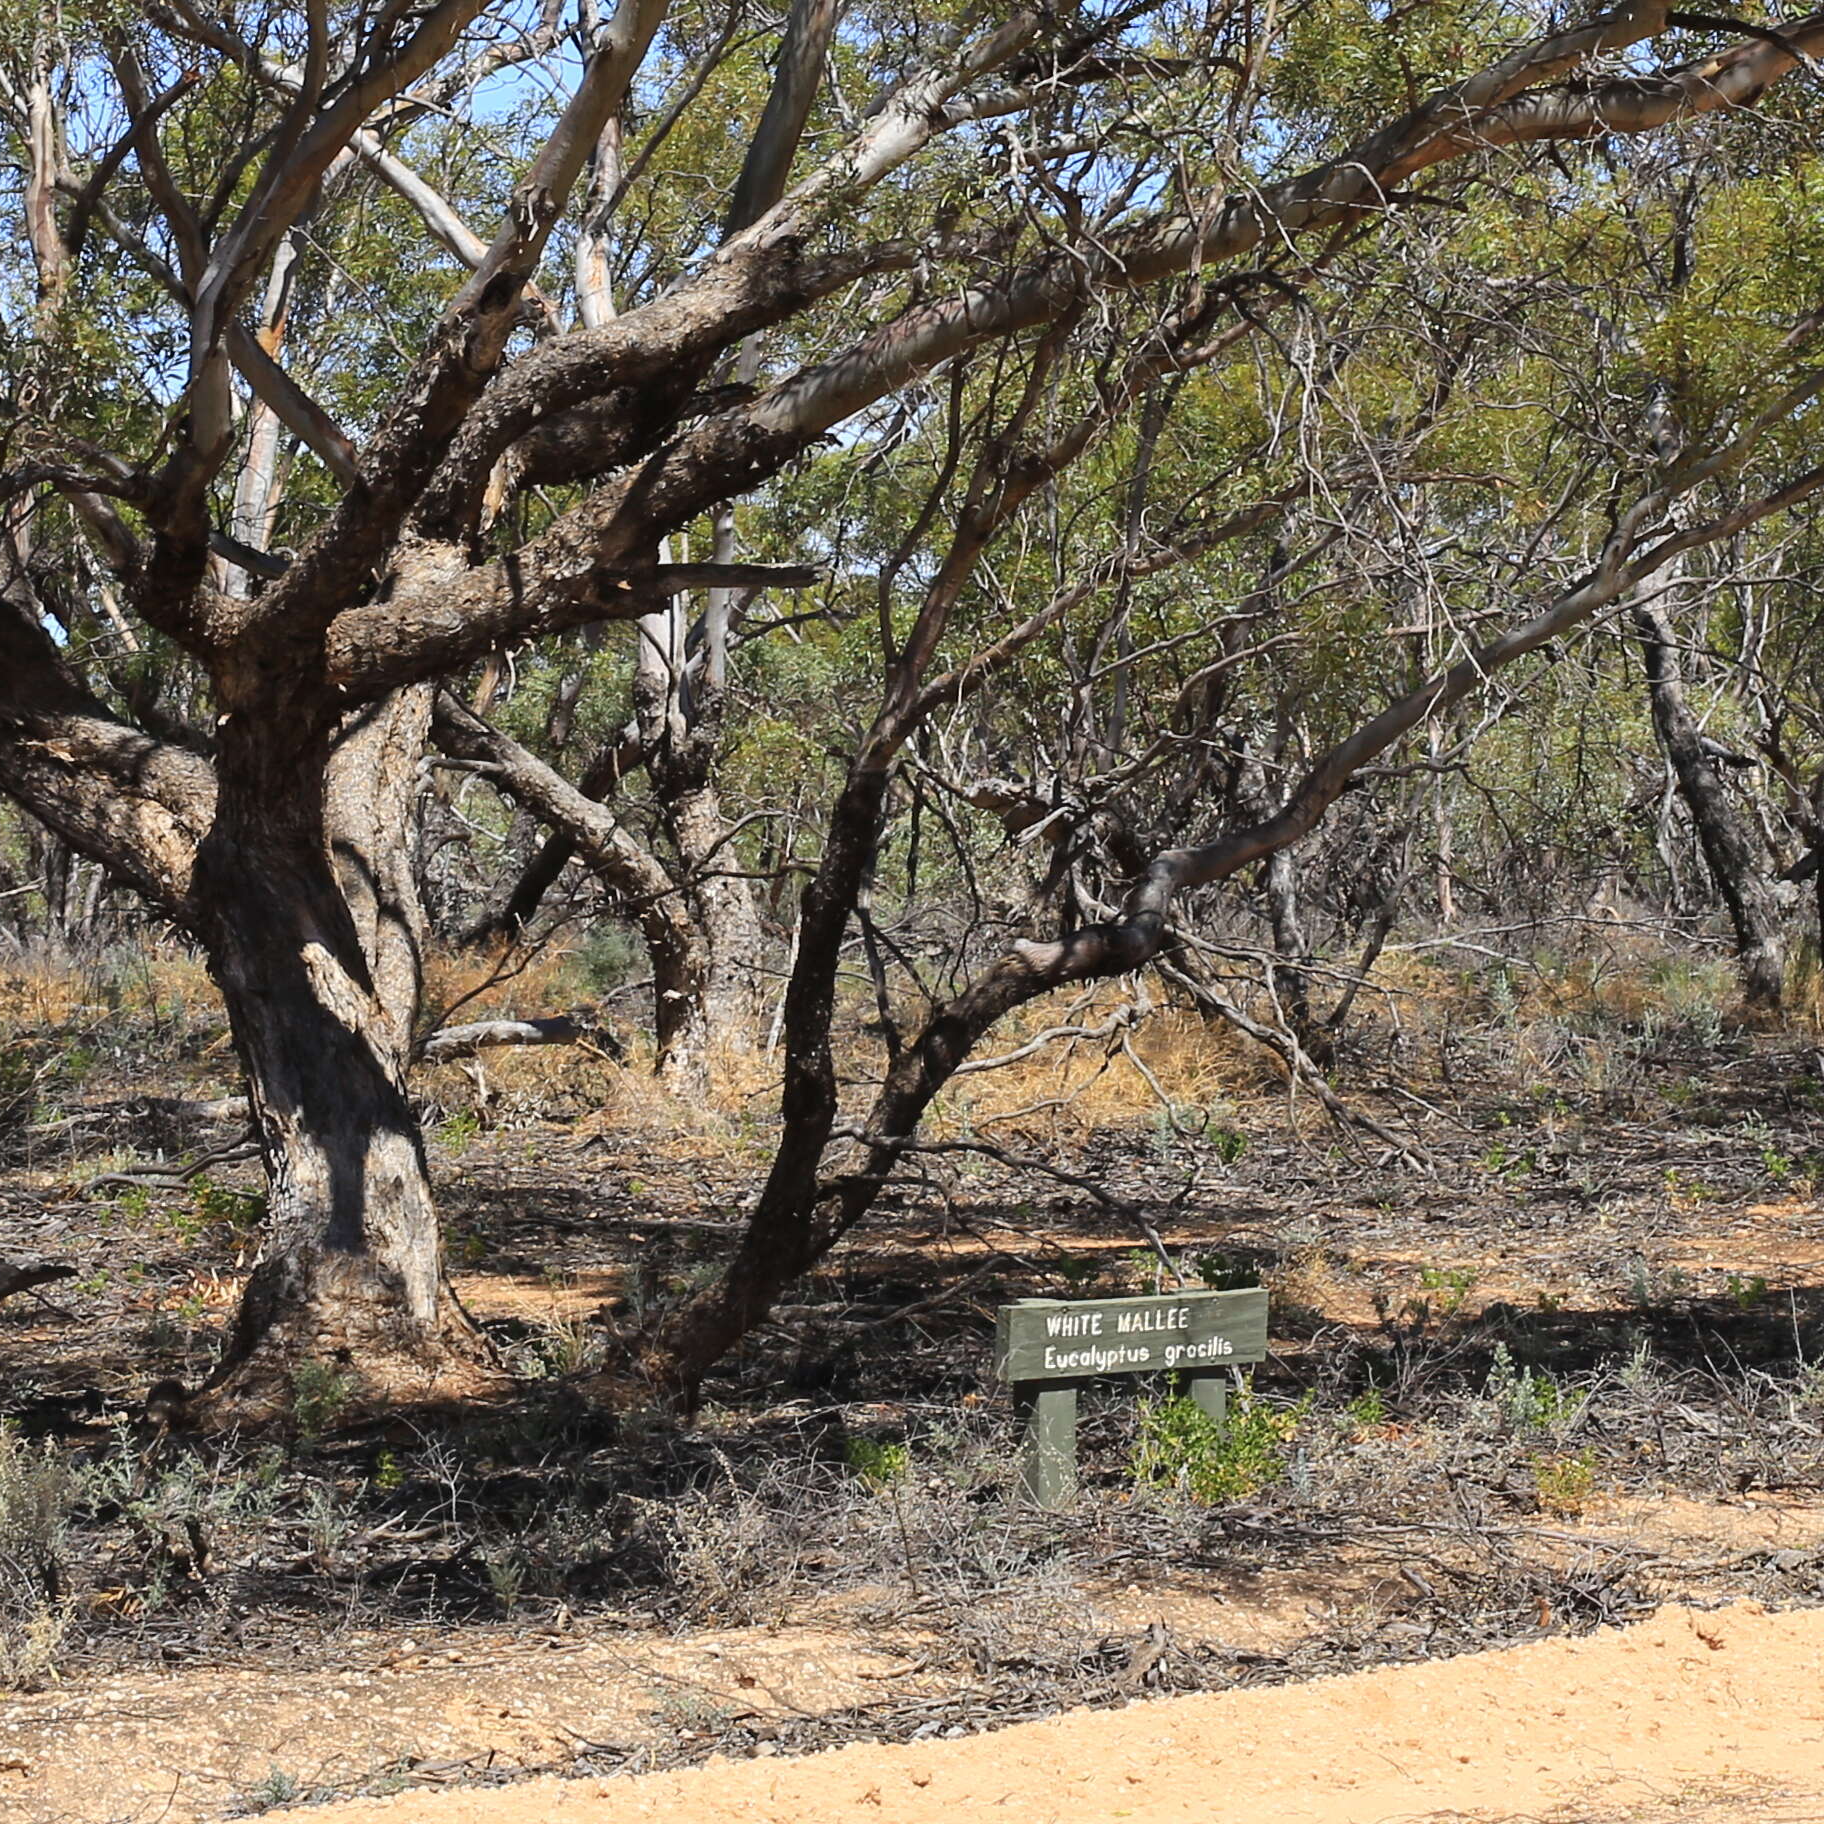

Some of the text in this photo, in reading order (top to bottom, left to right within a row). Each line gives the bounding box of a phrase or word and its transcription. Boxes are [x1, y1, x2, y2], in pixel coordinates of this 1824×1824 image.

[1046, 1307, 1190, 1337] WHITE MALLEE
[1044, 1344, 1150, 1371] Eucalyptus
